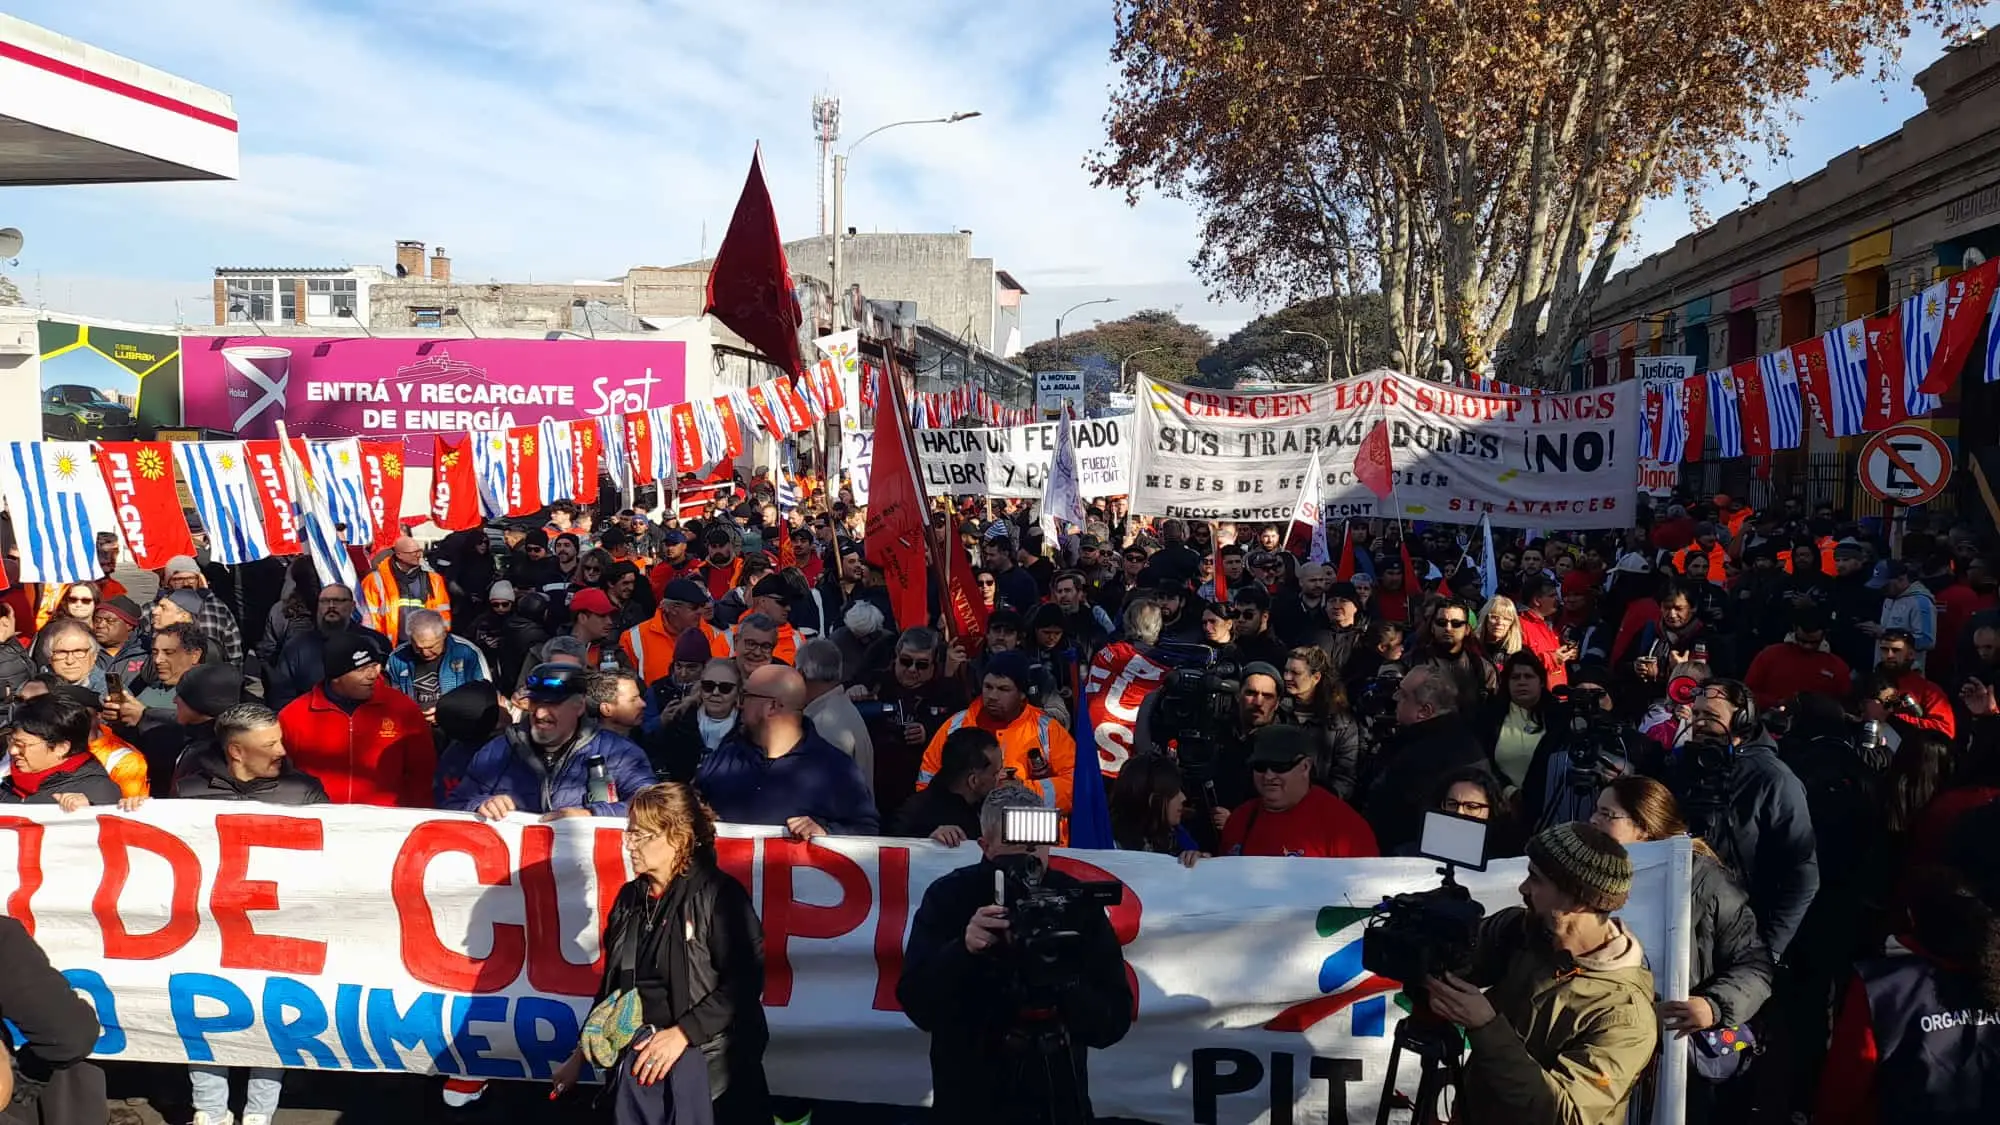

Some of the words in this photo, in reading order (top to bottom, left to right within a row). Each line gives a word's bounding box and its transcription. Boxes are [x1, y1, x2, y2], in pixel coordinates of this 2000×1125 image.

[1639, 361, 1685, 380] Justicia
[307, 379, 391, 402] ENTRÁ
[397, 383, 413, 402] Y
[420, 383, 574, 406] RECARGATE
[584, 368, 662, 415] Spot
[1183, 391, 1312, 419] CRECEN
[1335, 378, 1399, 411] LOS
[1415, 386, 1616, 424] SHOPPINGS
[363, 409, 397, 429] DE
[406, 406, 516, 431] ENERGÍA
[921, 430, 981, 454] HACIA
[987, 428, 1012, 453] UN
[1024, 420, 1119, 451] FEIADO
[1158, 426, 1219, 457] SUS
[1239, 419, 1500, 460] TRABAJDORES
[1001, 464, 1015, 488] Y
[1081, 455, 1117, 471] FUECYS
[256, 453, 298, 544] PIT-CNT
[1146, 474, 1224, 492] MESES
[1237, 479, 1264, 494] DE
[109, 452, 147, 558] PIT-CNT
[1448, 498, 1495, 513] SIN
[1505, 496, 1616, 515] AVANCES
[92, 813, 327, 975] DE
